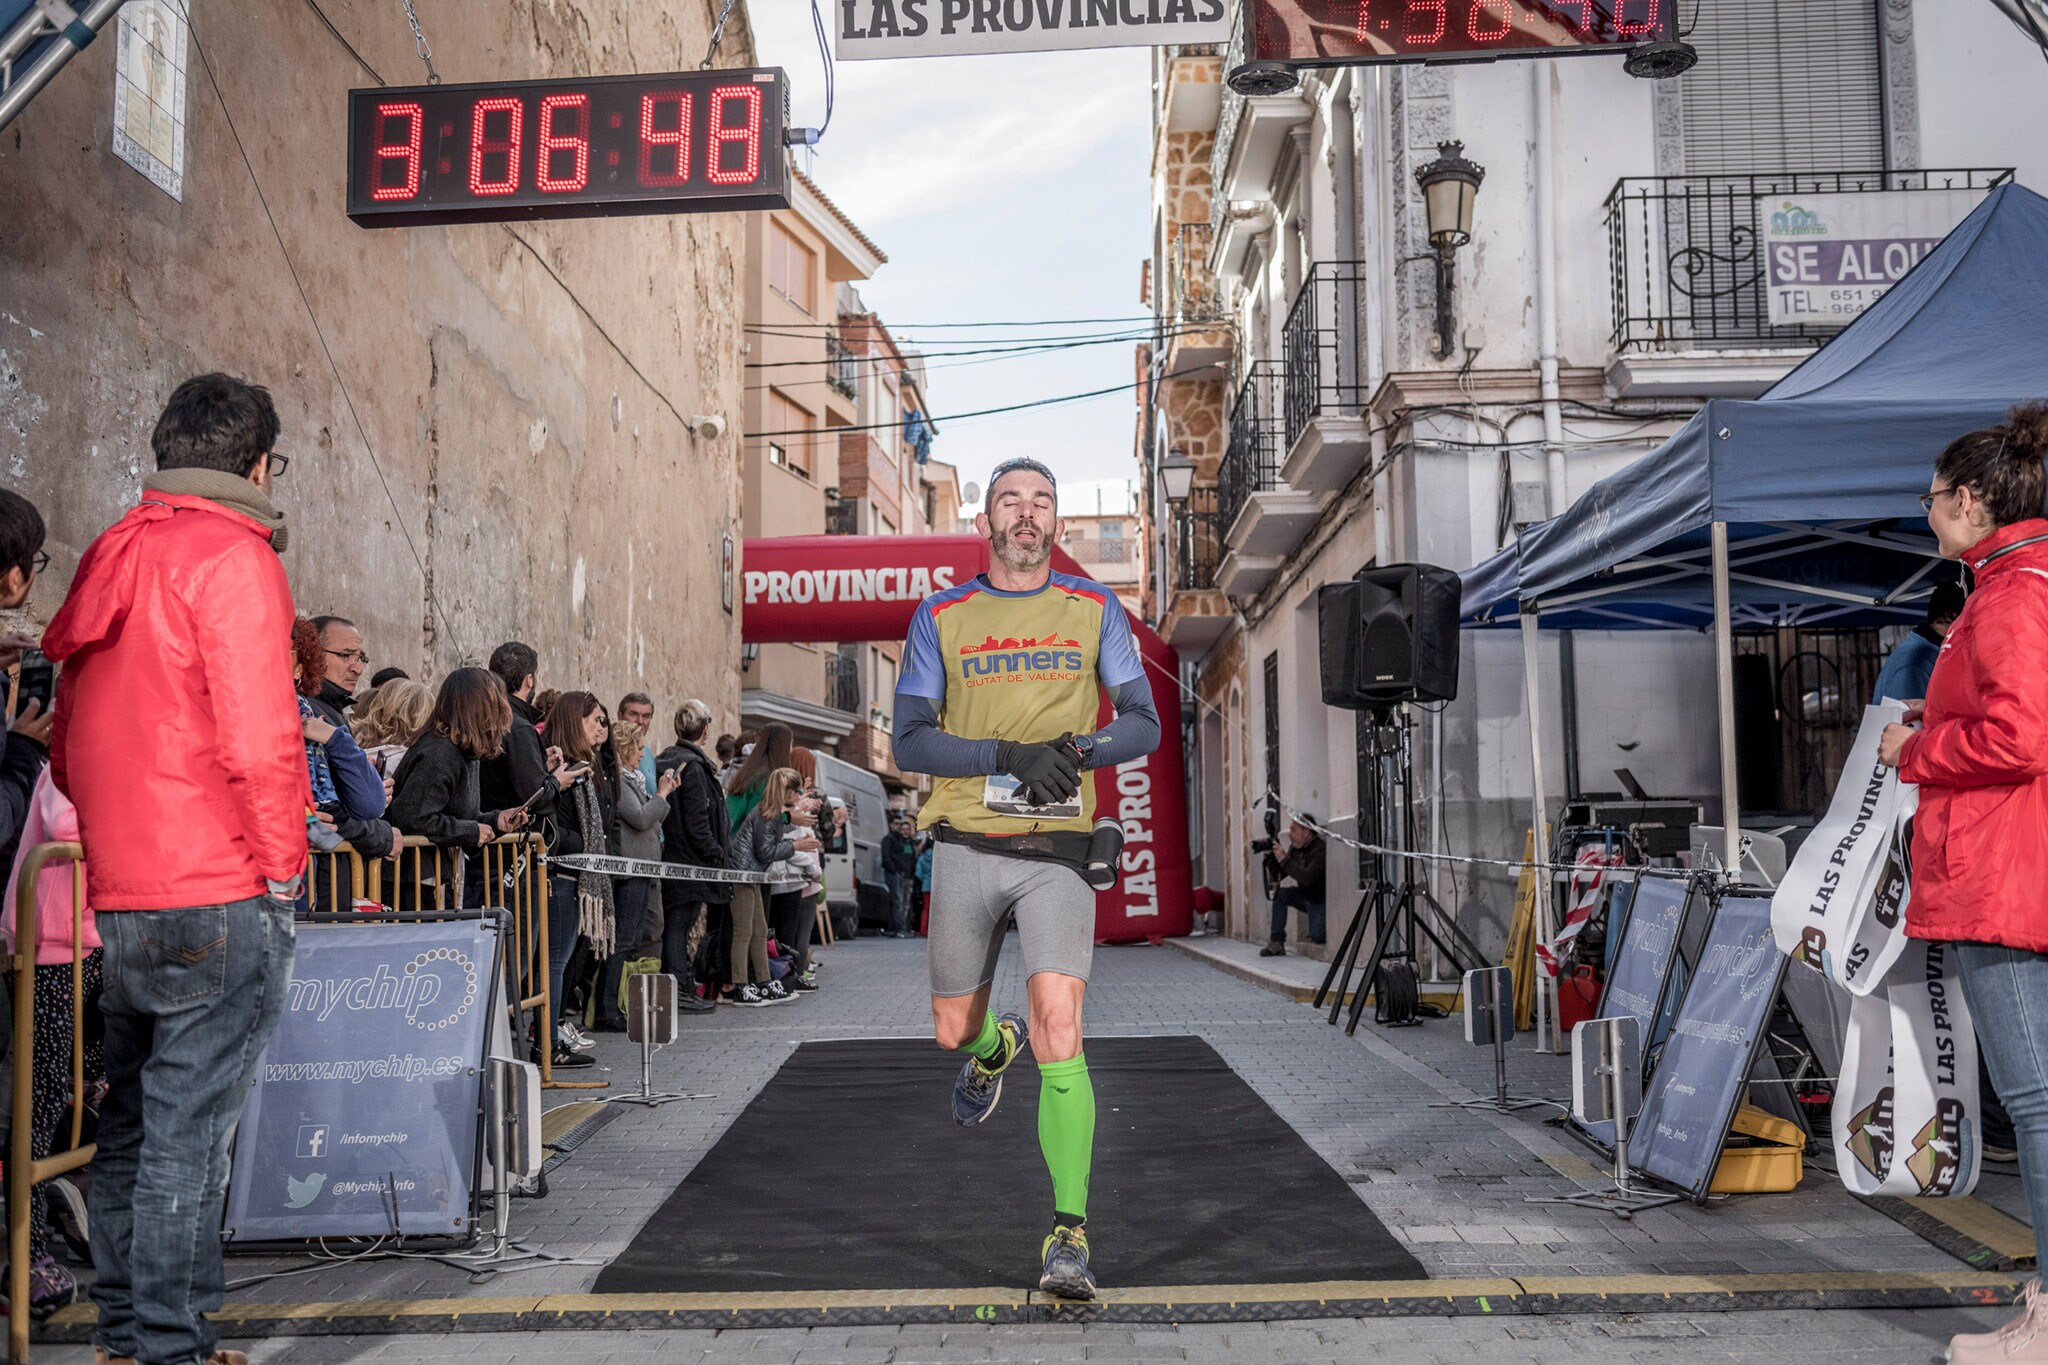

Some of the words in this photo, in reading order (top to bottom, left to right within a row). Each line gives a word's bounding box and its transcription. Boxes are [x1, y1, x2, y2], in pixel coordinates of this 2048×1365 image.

[842, 0, 928, 39] LAS
[940, 0, 1224, 35] PROVINCIAS
[1775, 245, 1820, 281] SE
[1837, 242, 1938, 281] ALQU
[1830, 290, 1863, 301] 651
[1871, 289, 1889, 300] 9
[744, 566, 955, 604] PROVINCIAS
[961, 650, 1082, 679] runners
[965, 675, 1003, 688] CIUTAT
[1007, 674, 1023, 683] DE
[1808, 868, 1841, 918] LAS
[1830, 763, 1889, 868] PROVINC
[1120, 848, 1159, 918] LAS
[1846, 942, 1871, 982] AS
[288, 965, 442, 1022] mychip
[264, 1053, 464, 1084] www.mychip.es
[1937, 1035, 1956, 1086] LAS
[340, 1132, 408, 1146] /infomychip
[332, 1180, 416, 1196] @Mychip_Info
